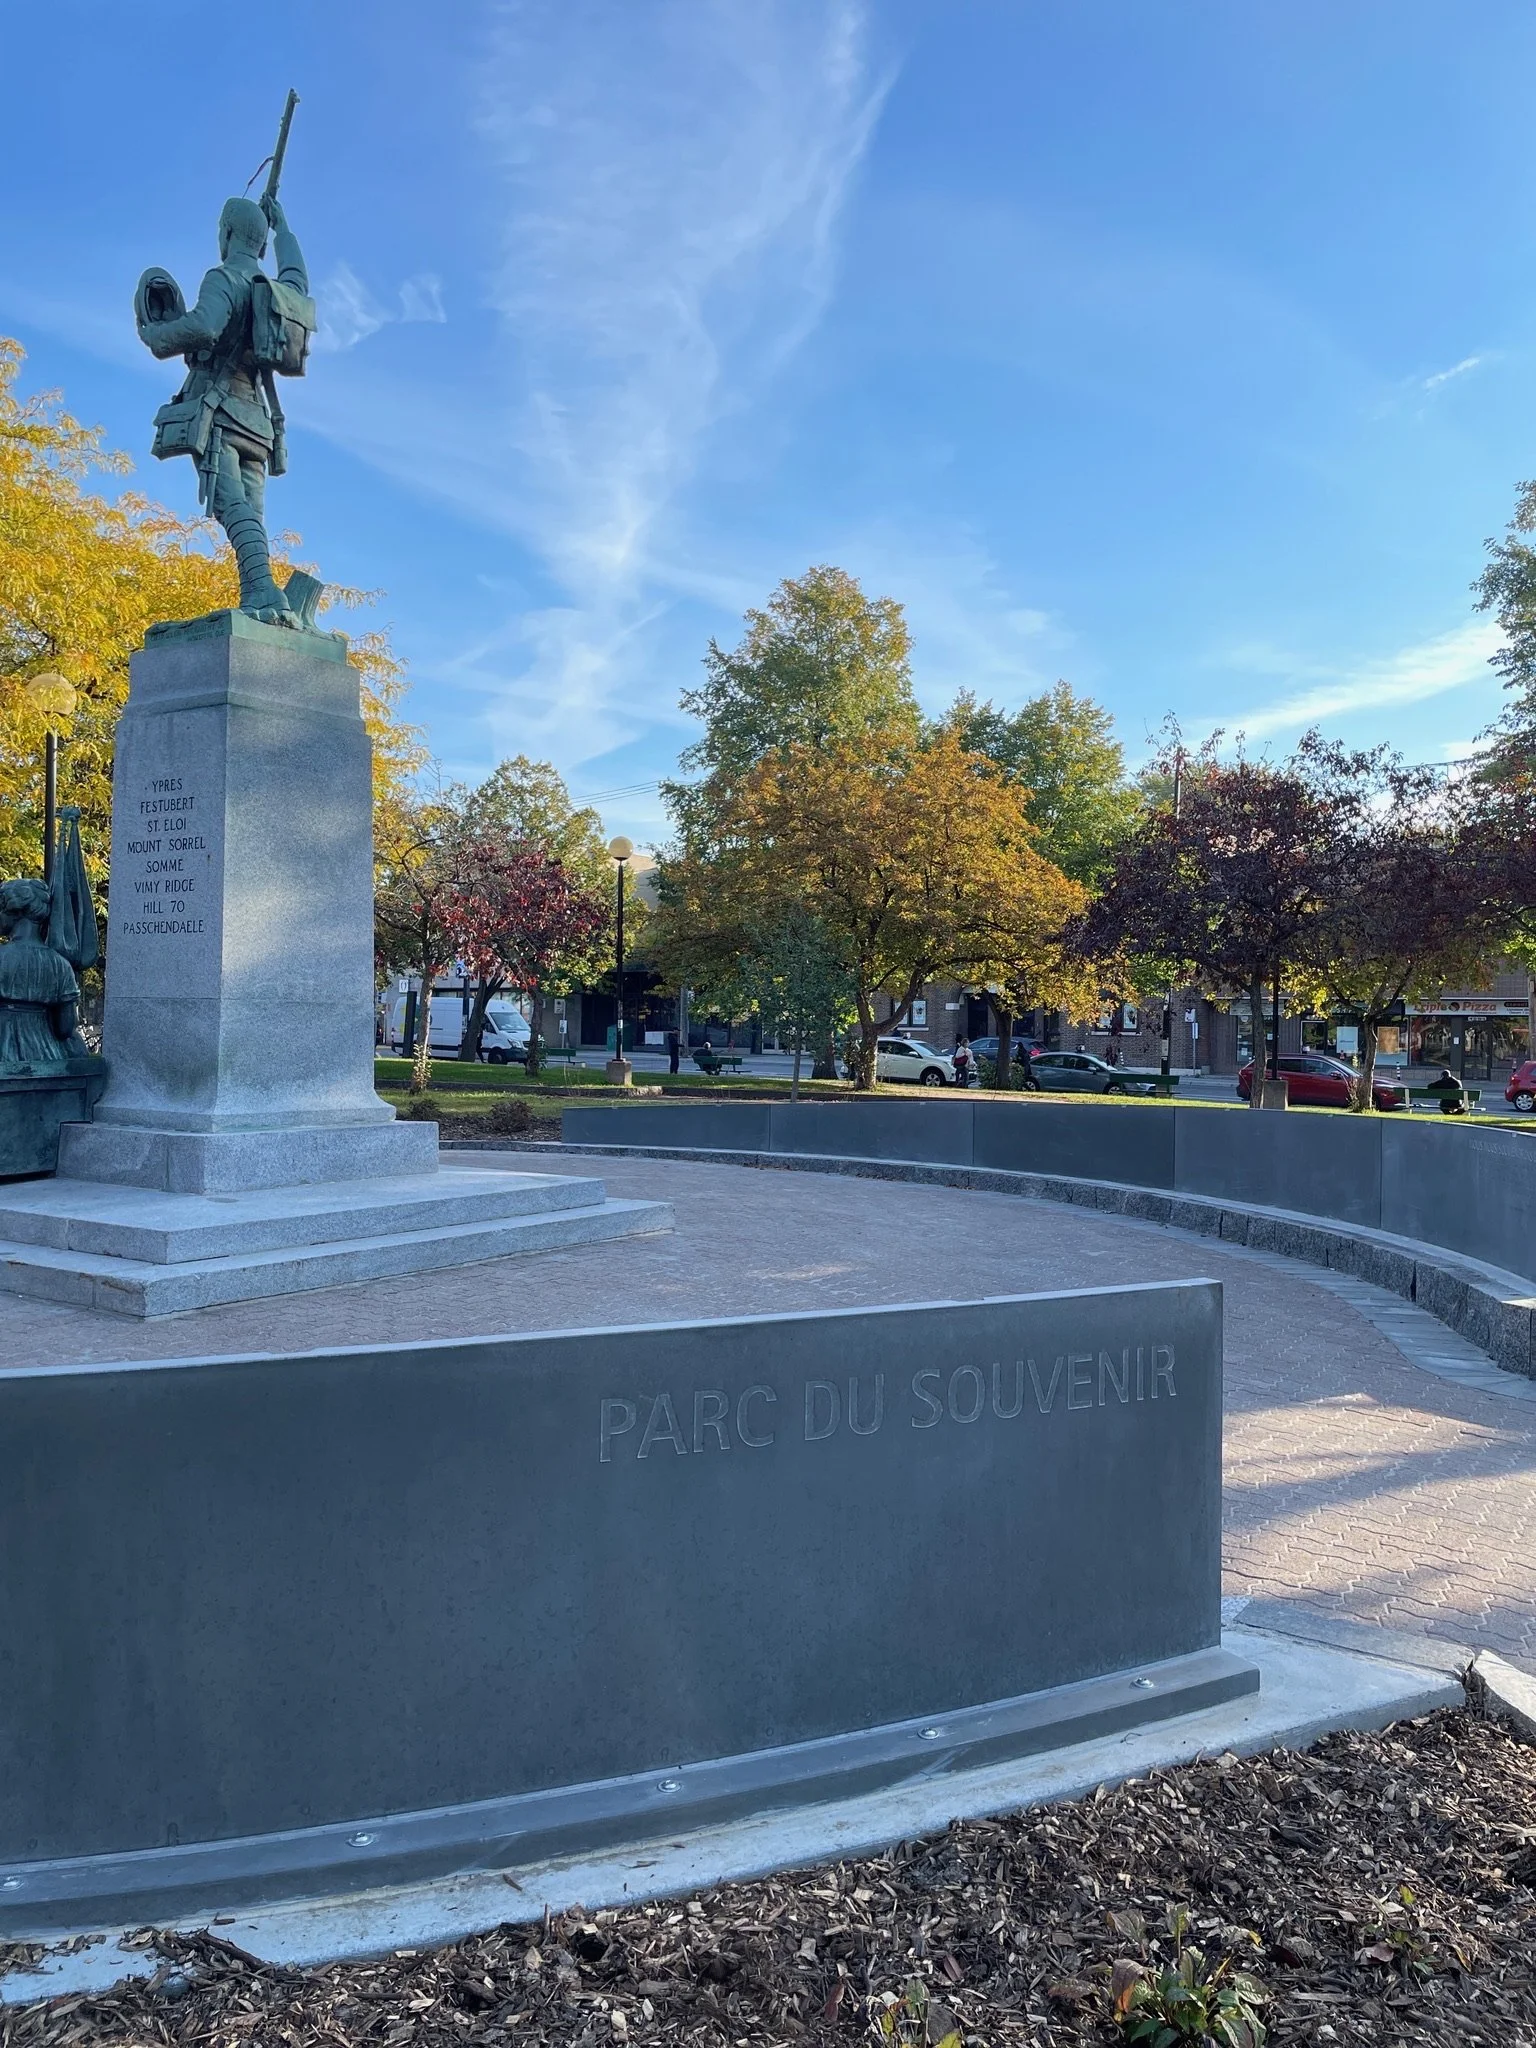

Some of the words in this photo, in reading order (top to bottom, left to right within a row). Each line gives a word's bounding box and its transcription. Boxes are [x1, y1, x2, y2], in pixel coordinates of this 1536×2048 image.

[152, 778, 183, 793] YPRES
[140, 796, 195, 814] FESTUBERT
[147, 820, 161, 833] ST.
[164, 818, 187, 832] ELOI
[128, 839, 161, 854] MOUNT
[168, 837, 206, 851] SORREL
[146, 859, 184, 873] SOMME
[134, 880, 160, 894] VIMY
[165, 879, 195, 893] RIDGE
[143, 901, 163, 914] HILL
[170, 900, 185, 913] 70
[123, 920, 204, 935] PASSCHENDAELE
[1462, 1001, 1497, 1012] Pizza
[599, 1384, 778, 1463] PARC
[803, 1373, 885, 1441] DU
[910, 1344, 1177, 1428] SOUVENIR
